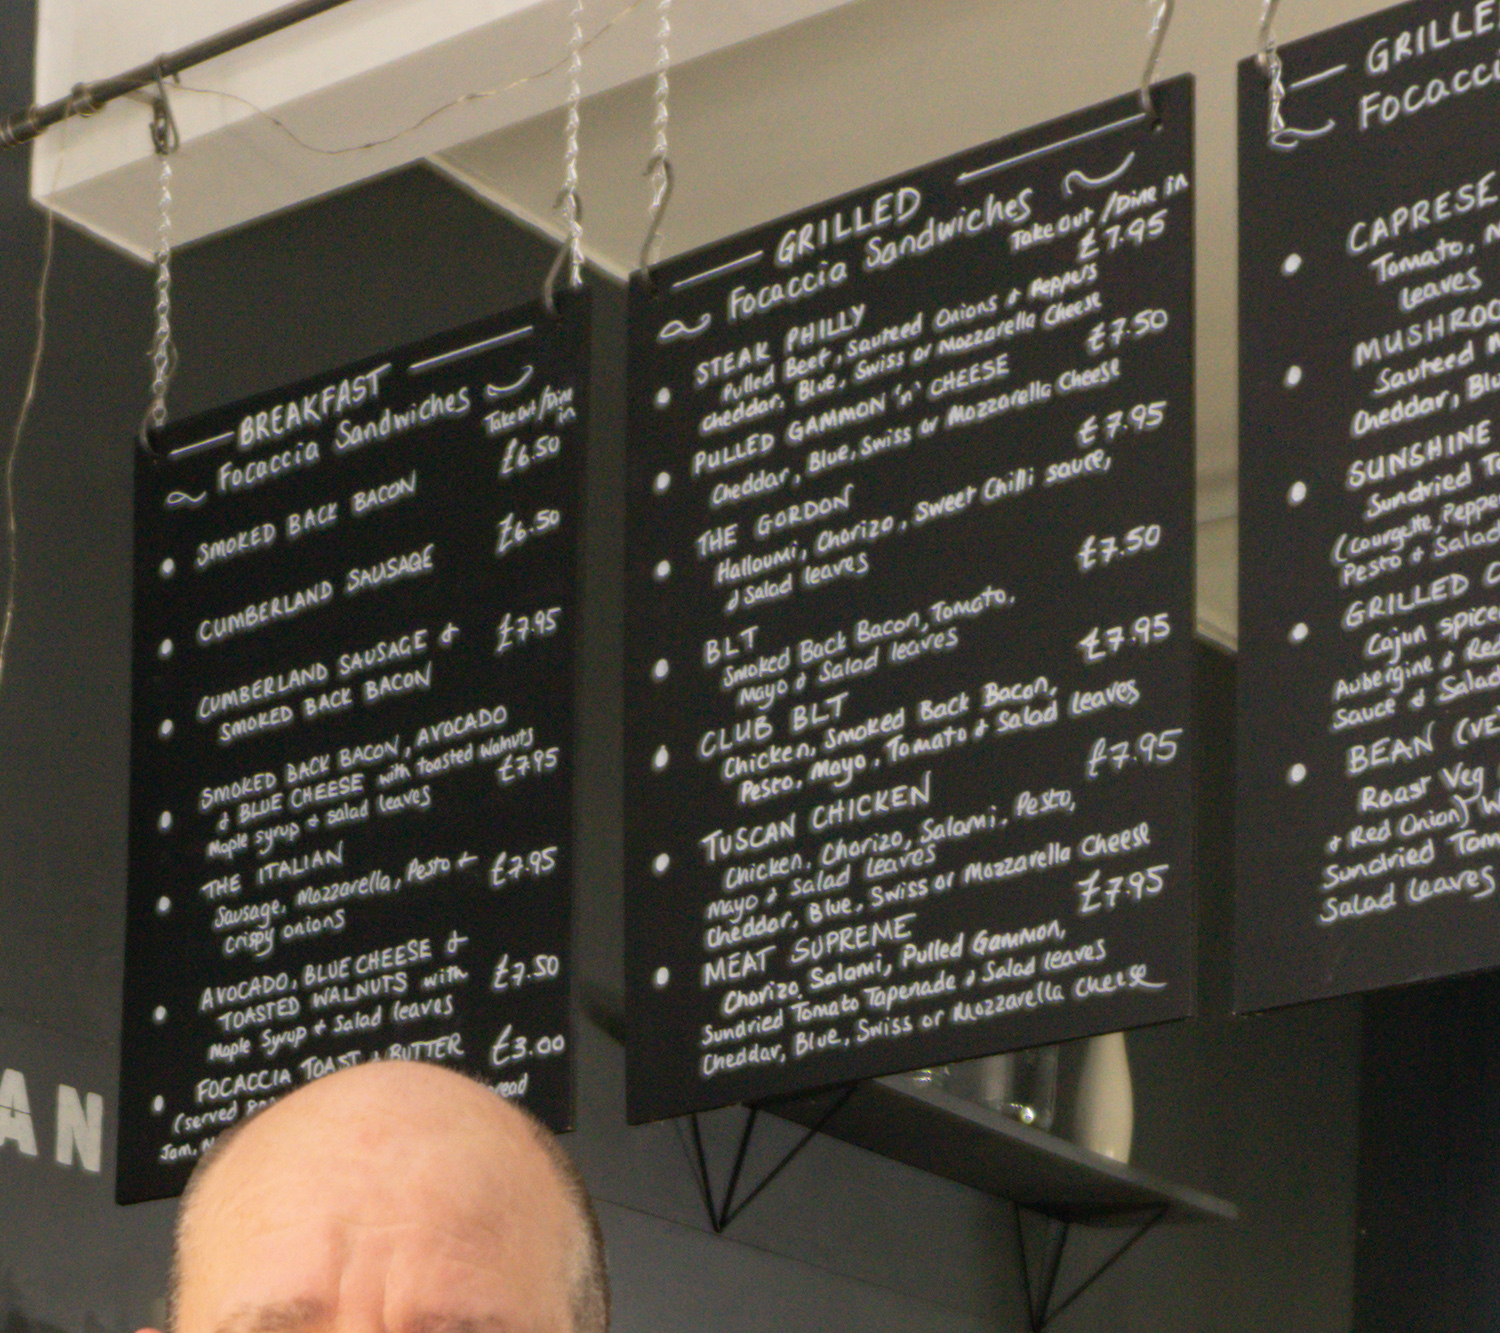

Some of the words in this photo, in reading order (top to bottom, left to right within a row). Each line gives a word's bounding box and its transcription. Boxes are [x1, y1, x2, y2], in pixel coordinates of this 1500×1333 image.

[776, 186, 922, 266] GRILLED
[1347, 170, 1499, 254] CAPRESE
[728, 260, 848, 320] Focaccia
[862, 186, 1033, 269] Sandwiches
[696, 341, 770, 386] STEAK
[785, 303, 866, 352] PHILLY
[217, 440, 320, 491] Focaccia
[334, 386, 471, 451] Sandwiches
[238, 362, 391, 448] BREAKFAST
[693, 432, 775, 475] PULLED
[786, 393, 886, 443] GAMMON
[929, 352, 1010, 398] CHEESE
[1348, 419, 1491, 489] SUNSHINE
[196, 522, 277, 568] SMOKED
[287, 502, 338, 537] BACK
[352, 472, 417, 513] BACON
[500, 434, 561, 475] £6.50
[697, 523, 738, 556] THE
[755, 483, 854, 537] GORDON
[197, 580, 334, 643] CUMBERLAND
[346, 543, 434, 593] SAUSAGE
[1343, 572, 1470, 632] GRILLED
[704, 625, 759, 665] BLT
[699, 714, 774, 758] CLUB
[791, 691, 849, 732] BLT
[1347, 721, 1434, 775] BEAN
[700, 812, 796, 862] TUSCAN
[811, 770, 931, 831] CHICKEN
[201, 874, 241, 898] THE
[257, 840, 343, 885] ITALIAN
[490, 845, 558, 887] £7.95
[303, 956, 351, 987] BLUE
[354, 938, 432, 975] CHEESE
[492, 954, 560, 990] £7.50
[703, 945, 776, 986] MEAT
[790, 912, 917, 964] SUPREME
